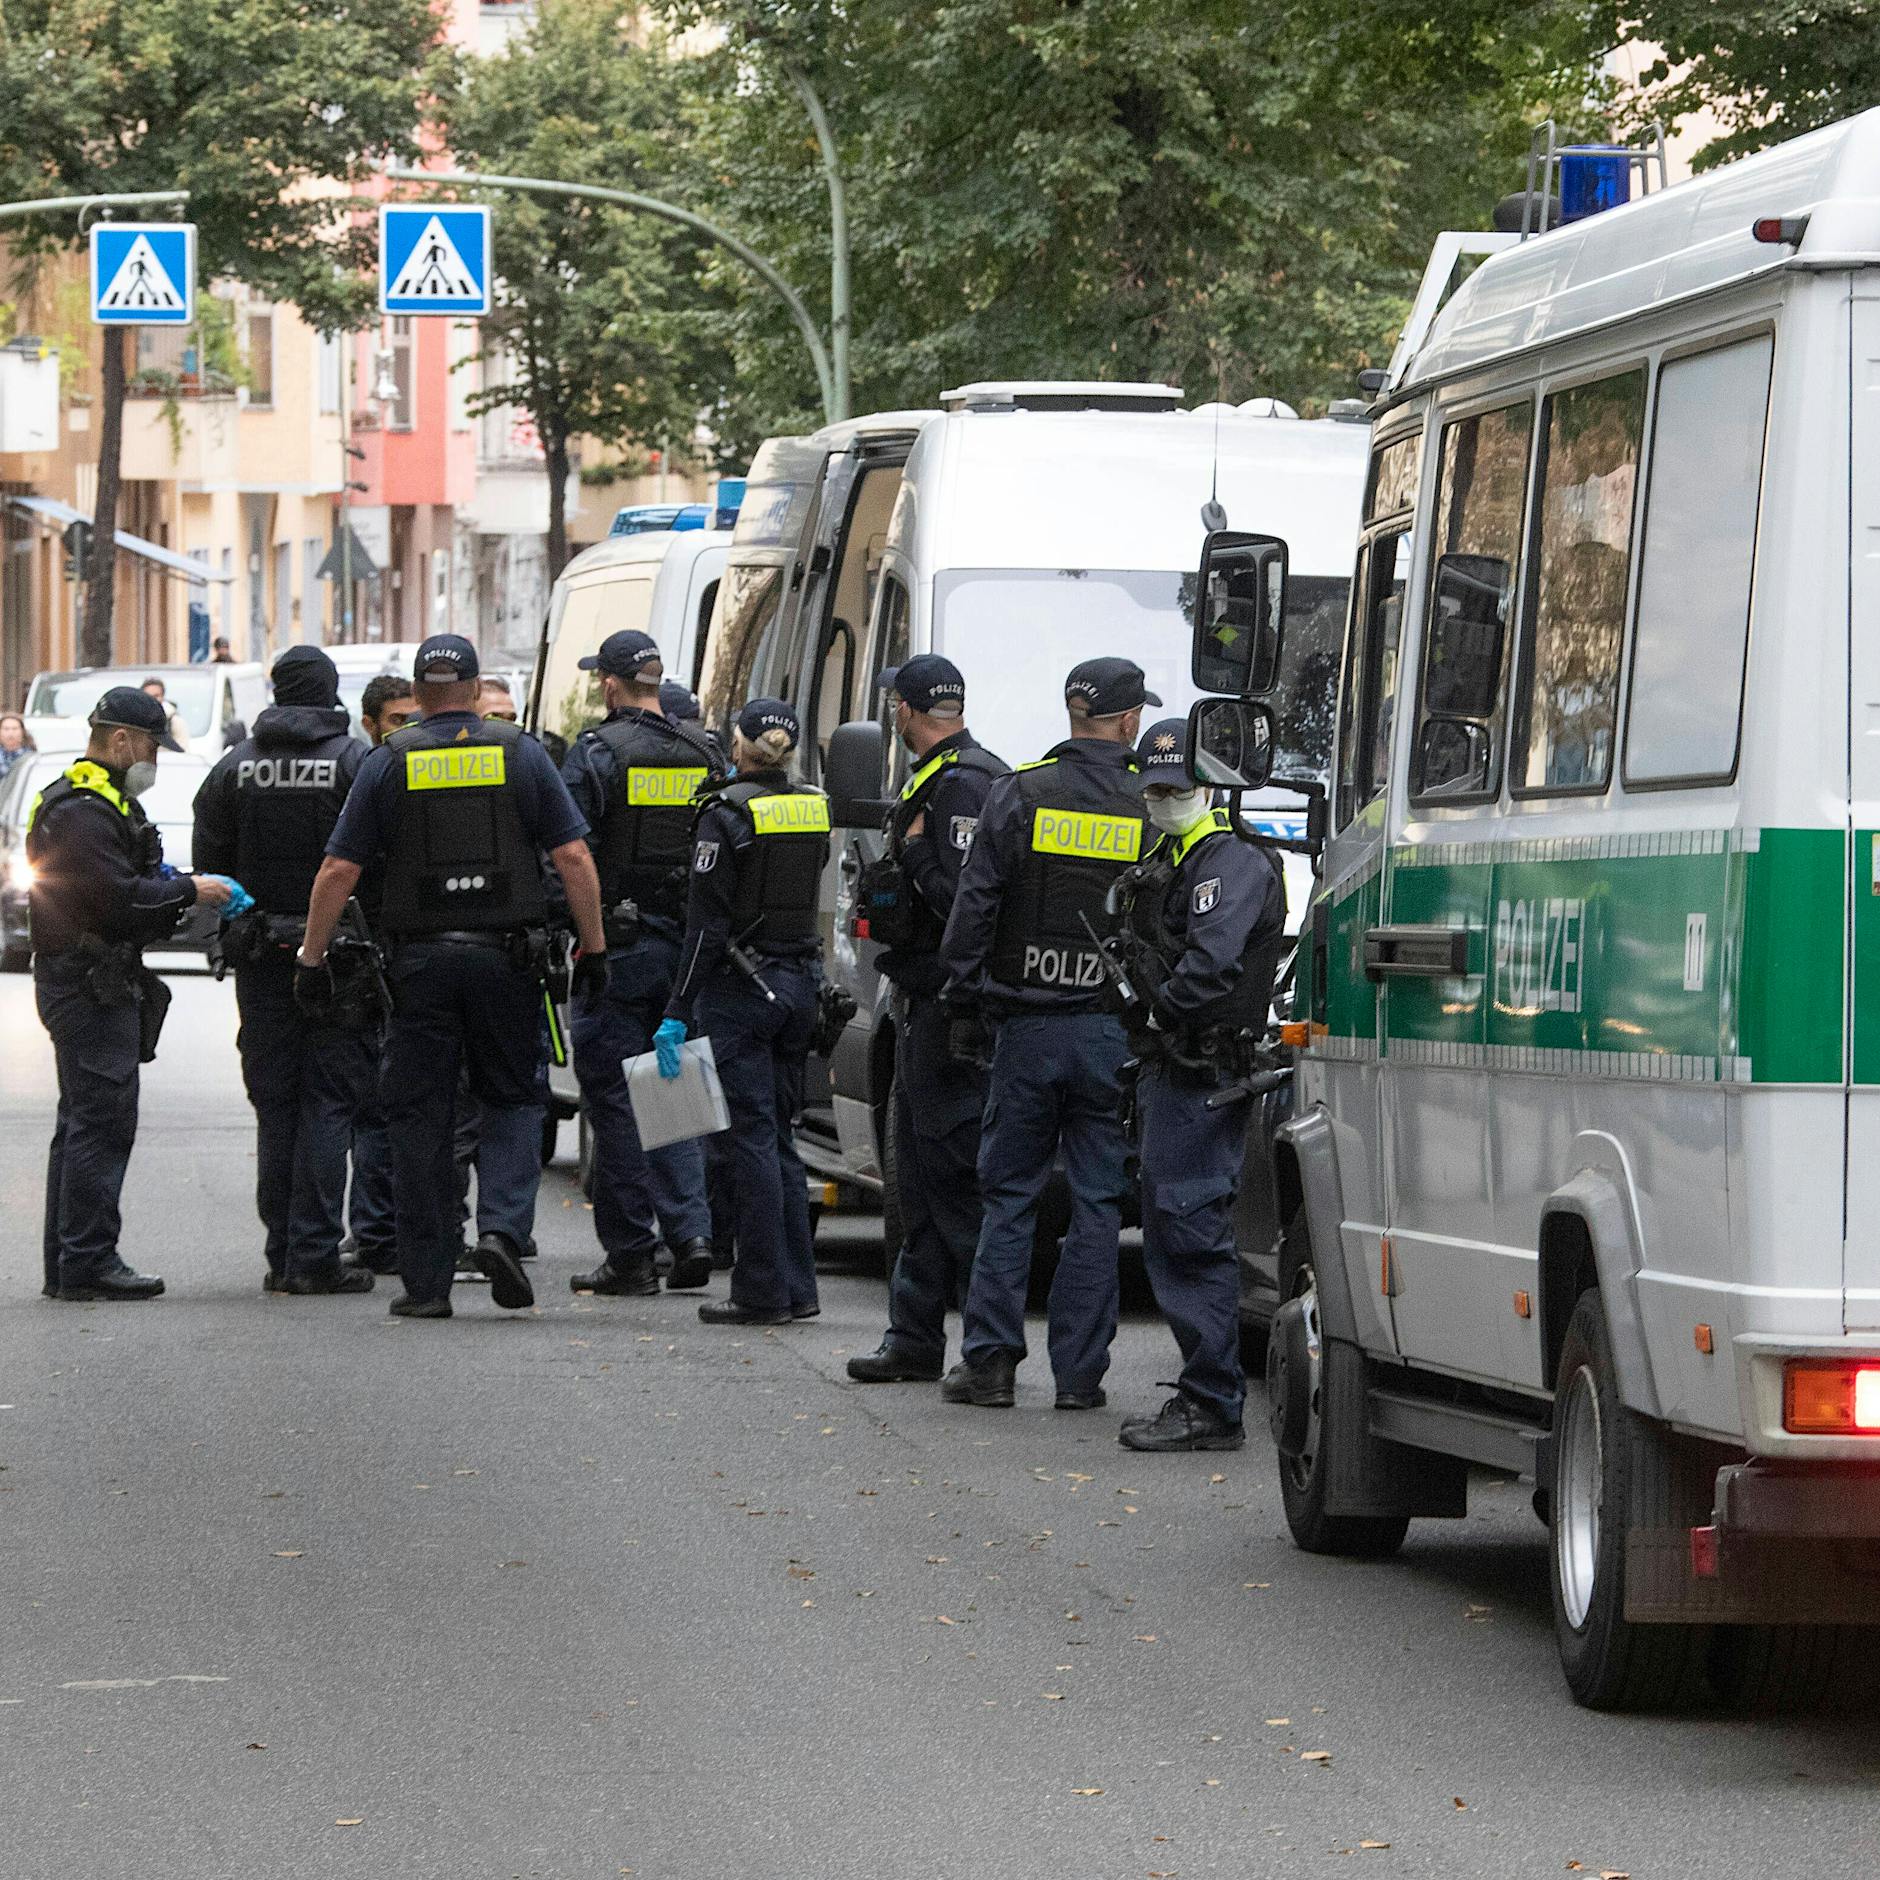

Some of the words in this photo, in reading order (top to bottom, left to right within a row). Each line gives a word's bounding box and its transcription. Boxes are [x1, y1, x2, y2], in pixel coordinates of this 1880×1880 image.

[424, 649, 461, 661] POLIZEI
[761, 714, 797, 732] POLIZEI
[237, 758, 338, 789] POLIZEI
[412, 752, 500, 785] POLIZEI
[1147, 753, 1185, 766] POLIZEI
[633, 773, 704, 800] POLIZE
[757, 800, 826, 827] POLIZEI
[1039, 816, 1136, 856] POLIZEI
[1023, 945, 1101, 988] POLIZ
[1494, 898, 1586, 1013] POLIZEI
